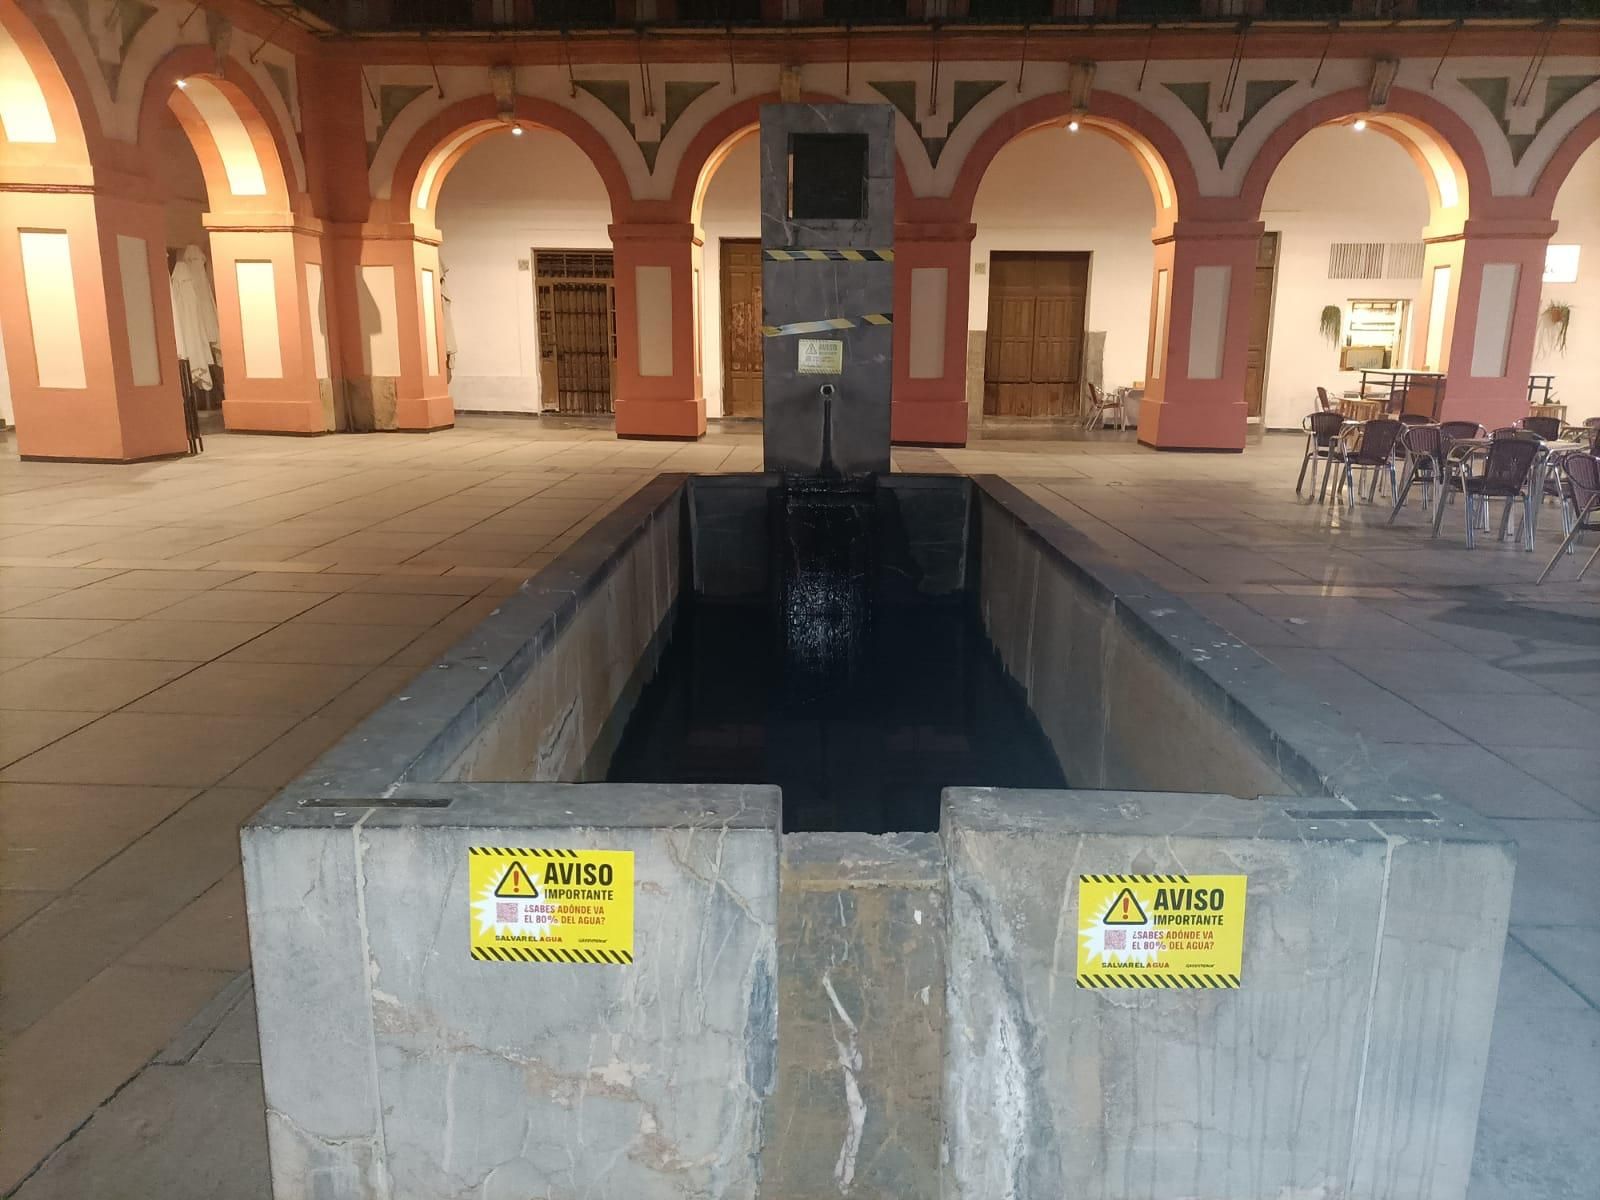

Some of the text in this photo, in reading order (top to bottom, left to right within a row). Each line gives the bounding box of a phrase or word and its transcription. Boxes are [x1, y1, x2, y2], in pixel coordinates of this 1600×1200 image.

[544, 862, 613, 886] AVISO
[544, 889, 614, 901] IMPORTANTE
[1153, 888, 1224, 911] AVISO
[524, 904, 605, 915] ¿SABES ADÓNDE VA
[524, 915, 606, 925] EL 80% DEL AGUA?
[1153, 914, 1224, 926] IMPORTANTE
[1132, 930, 1214, 940] ¿SABES ADÓNDE VA
[1132, 941, 1215, 950] EL 80% DEL AGUA?
